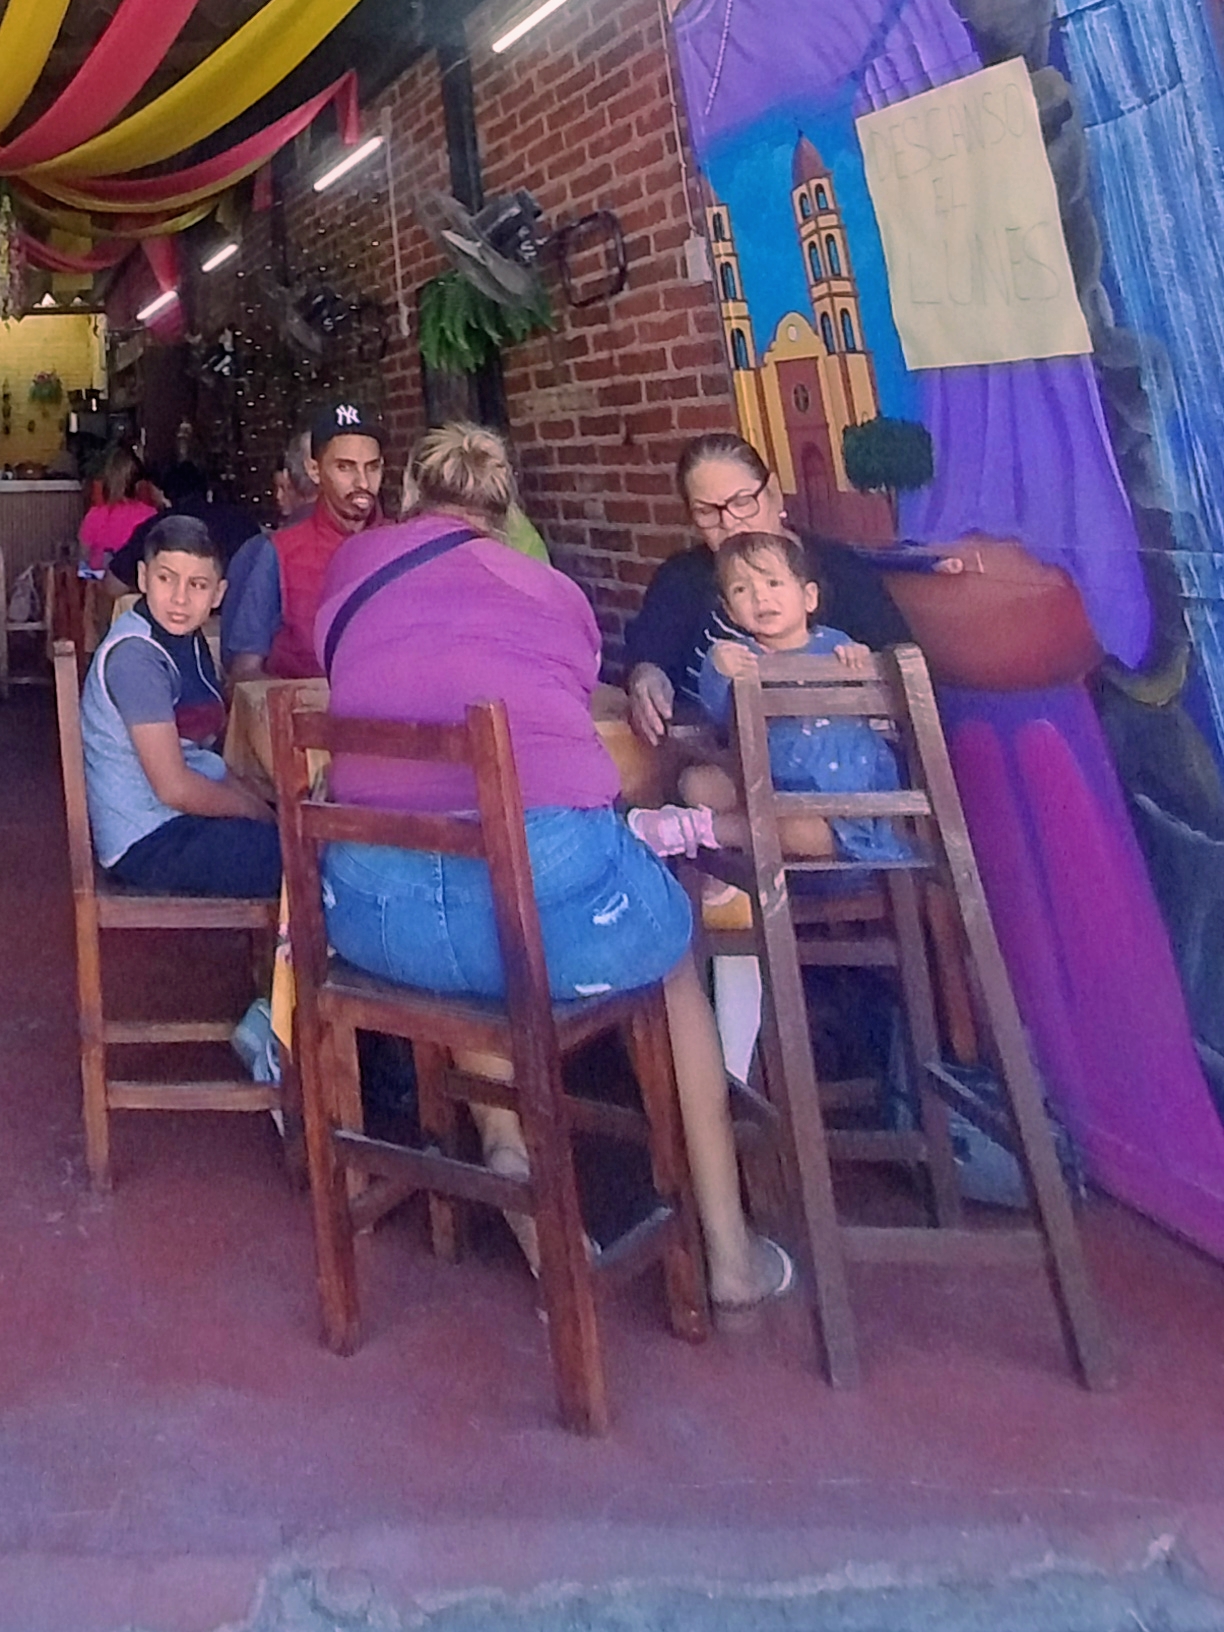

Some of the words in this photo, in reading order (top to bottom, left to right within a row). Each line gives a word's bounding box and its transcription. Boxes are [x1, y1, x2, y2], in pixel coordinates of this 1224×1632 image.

[869, 83, 1026, 182] DESCANSO
[932, 176, 968, 215] EL
[907, 220, 1061, 307] LUNES
[335, 404, 362, 426] NY
